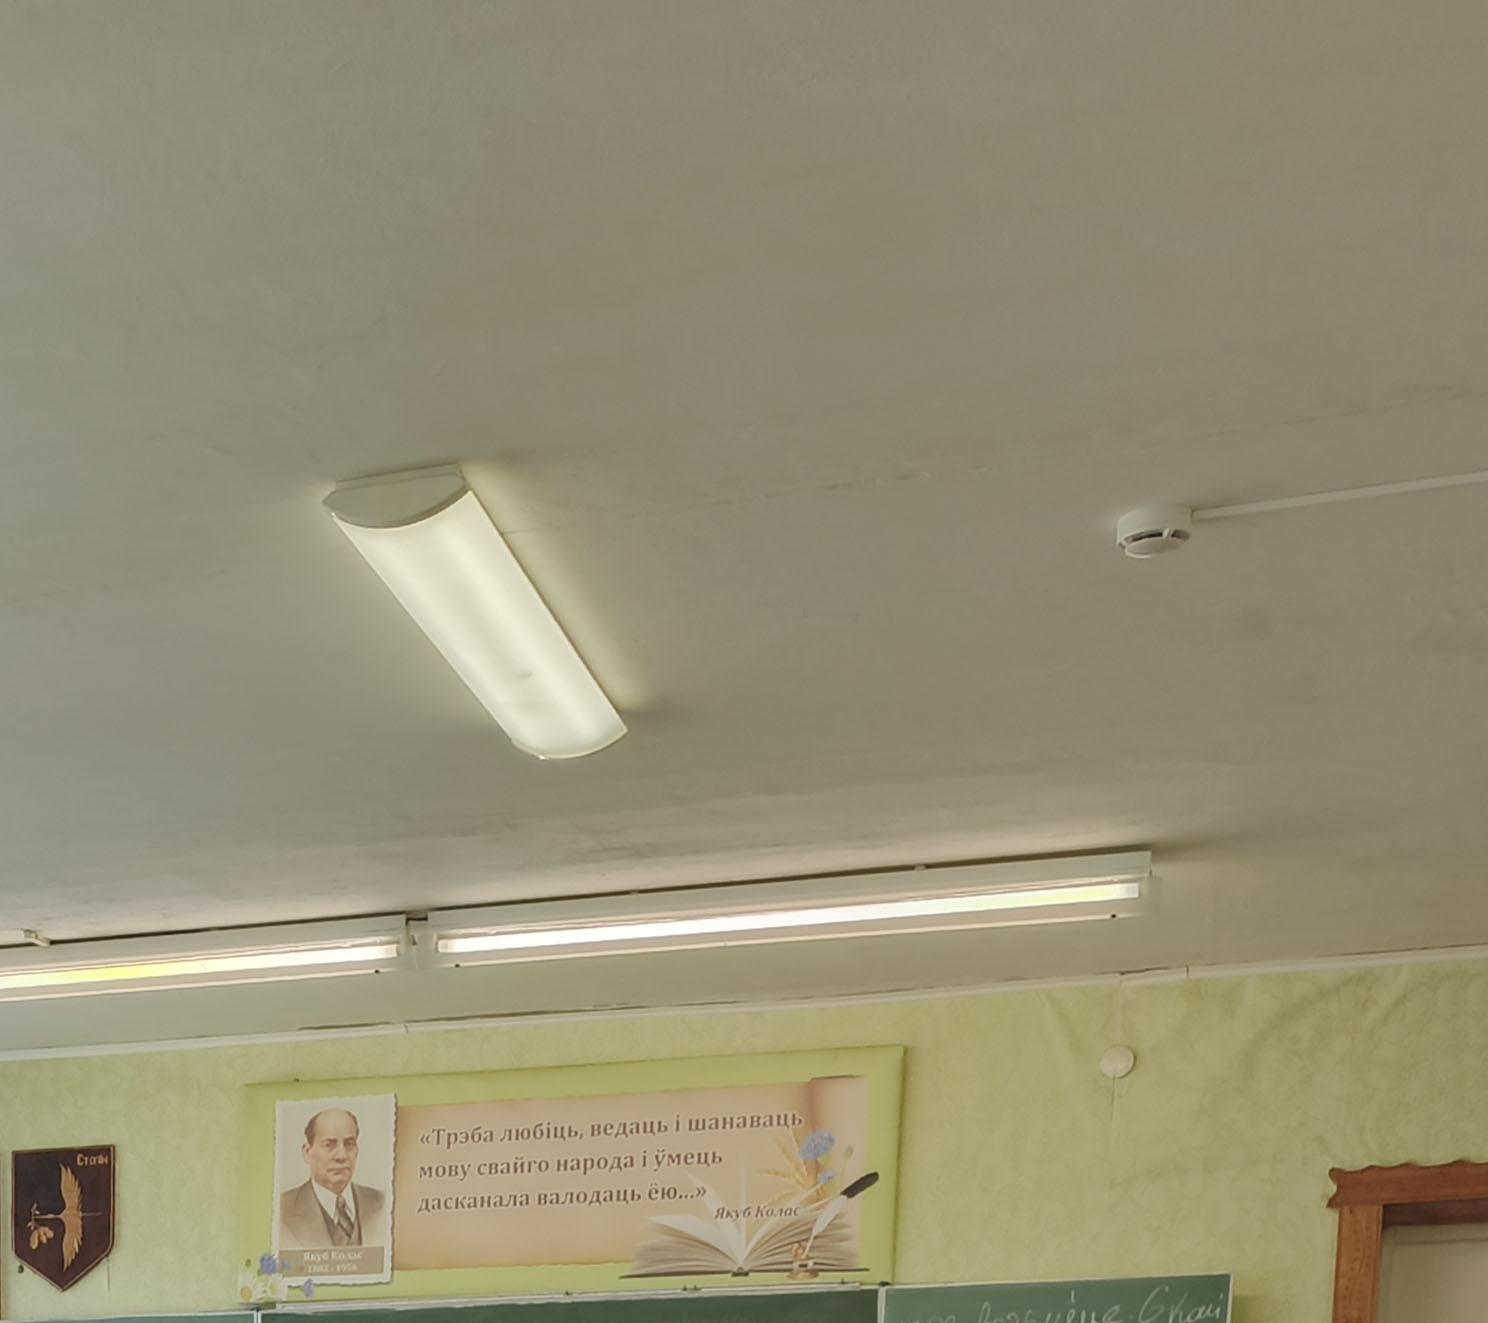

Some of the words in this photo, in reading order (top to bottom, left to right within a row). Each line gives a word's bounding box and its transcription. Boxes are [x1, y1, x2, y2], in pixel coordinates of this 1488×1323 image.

[420, 1126, 494, 1149] «Трэба
[500, 1122, 584, 1142] любіць,
[591, 1119, 669, 1137] ведаць
[674, 1114, 681, 1132] і
[688, 1112, 803, 1132] шанаваць
[419, 1163, 471, 1181] мову
[477, 1156, 550, 1175] свайго
[556, 1154, 635, 1175] народа
[641, 1150, 648, 1168] і
[654, 1148, 723, 1172] ўмець
[417, 1192, 530, 1214] дасканала
[537, 1187, 642, 1206] валодаць
[647, 1183, 707, 1201] ёю...»
[713, 1206, 752, 1222] Якуб
[755, 1205, 800, 1219] Колас
